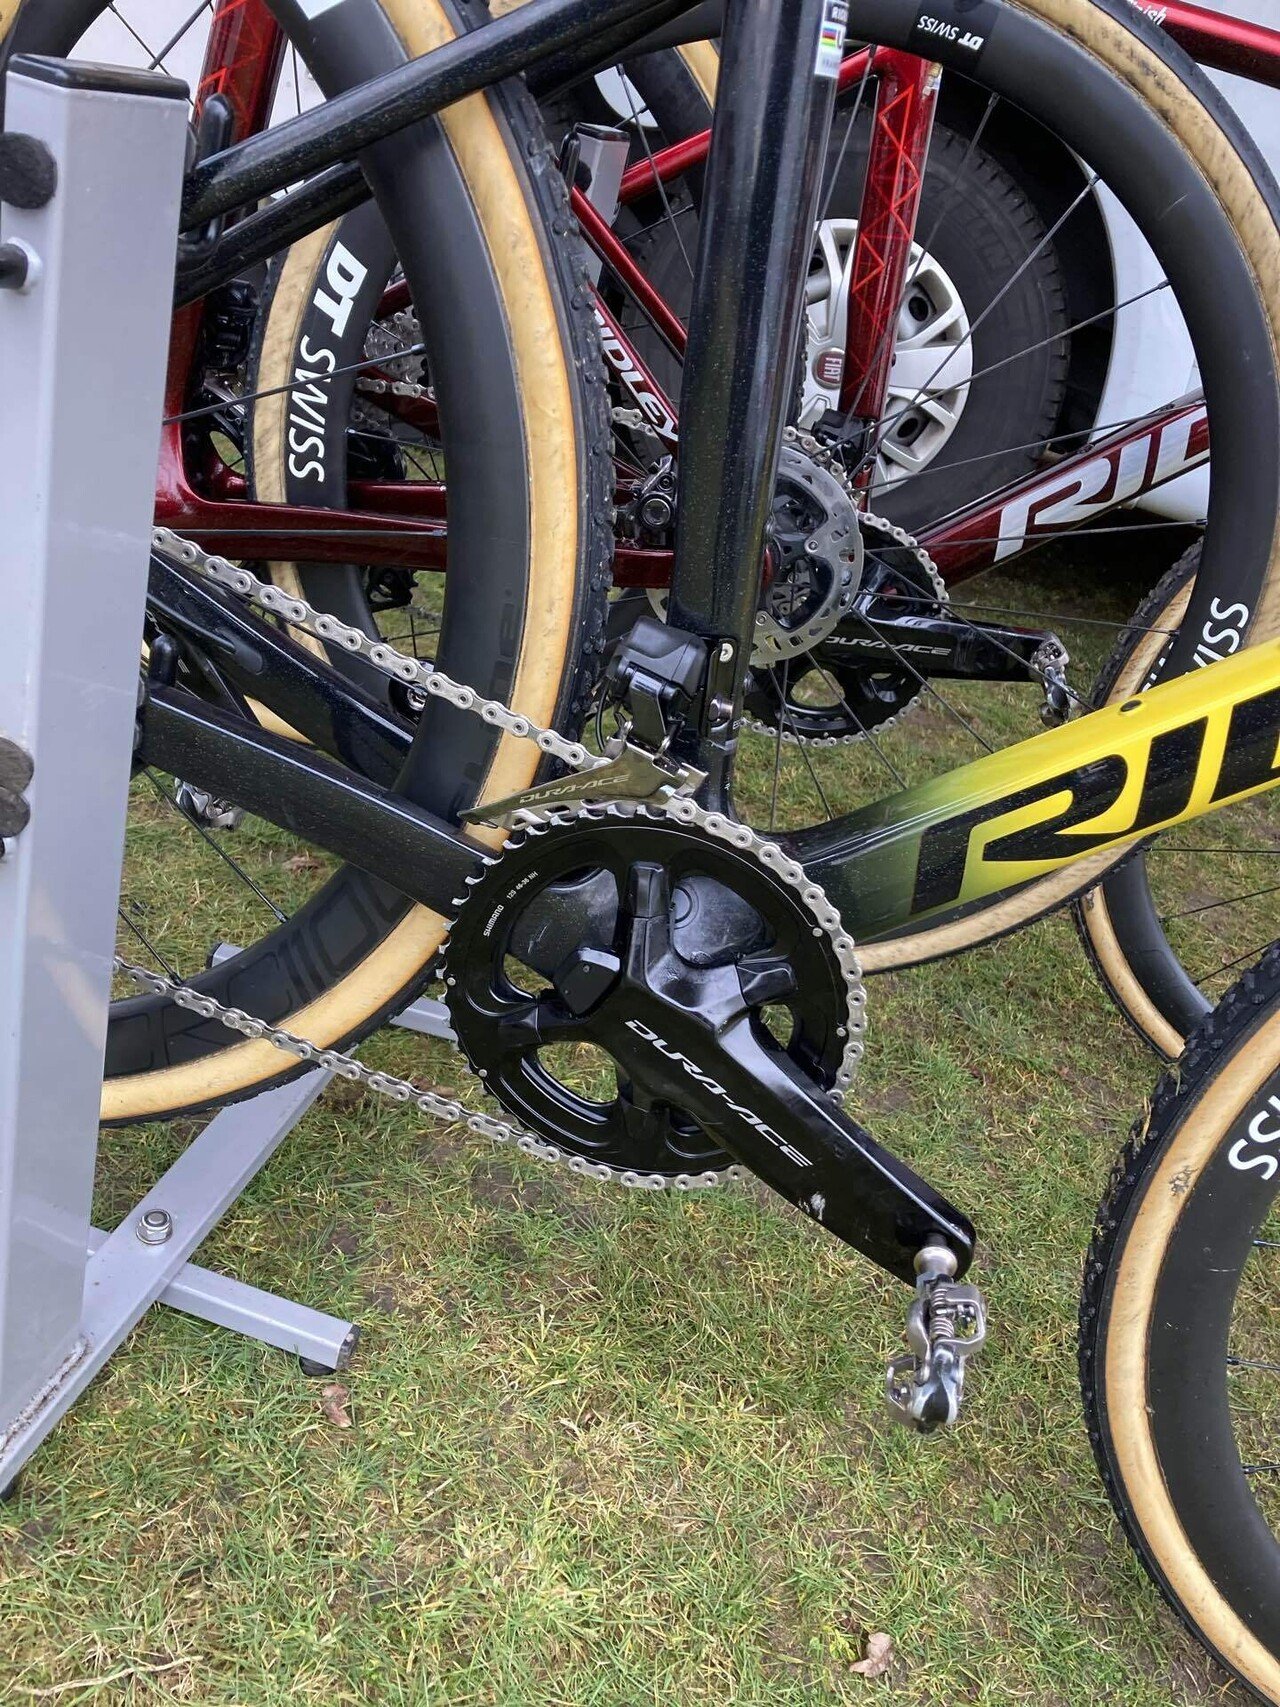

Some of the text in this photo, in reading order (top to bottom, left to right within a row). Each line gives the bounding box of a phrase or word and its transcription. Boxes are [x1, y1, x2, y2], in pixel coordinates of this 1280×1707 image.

[917, 15, 985, 51] DT SWISS
[288, 240, 369, 483] DT SWISS
[823, 357, 843, 382] FIAT
[519, 774, 630, 804] DURA-ACE
[483, 904, 505, 937] SHIMANO
[624, 1019, 814, 1168] DURA-ACE
